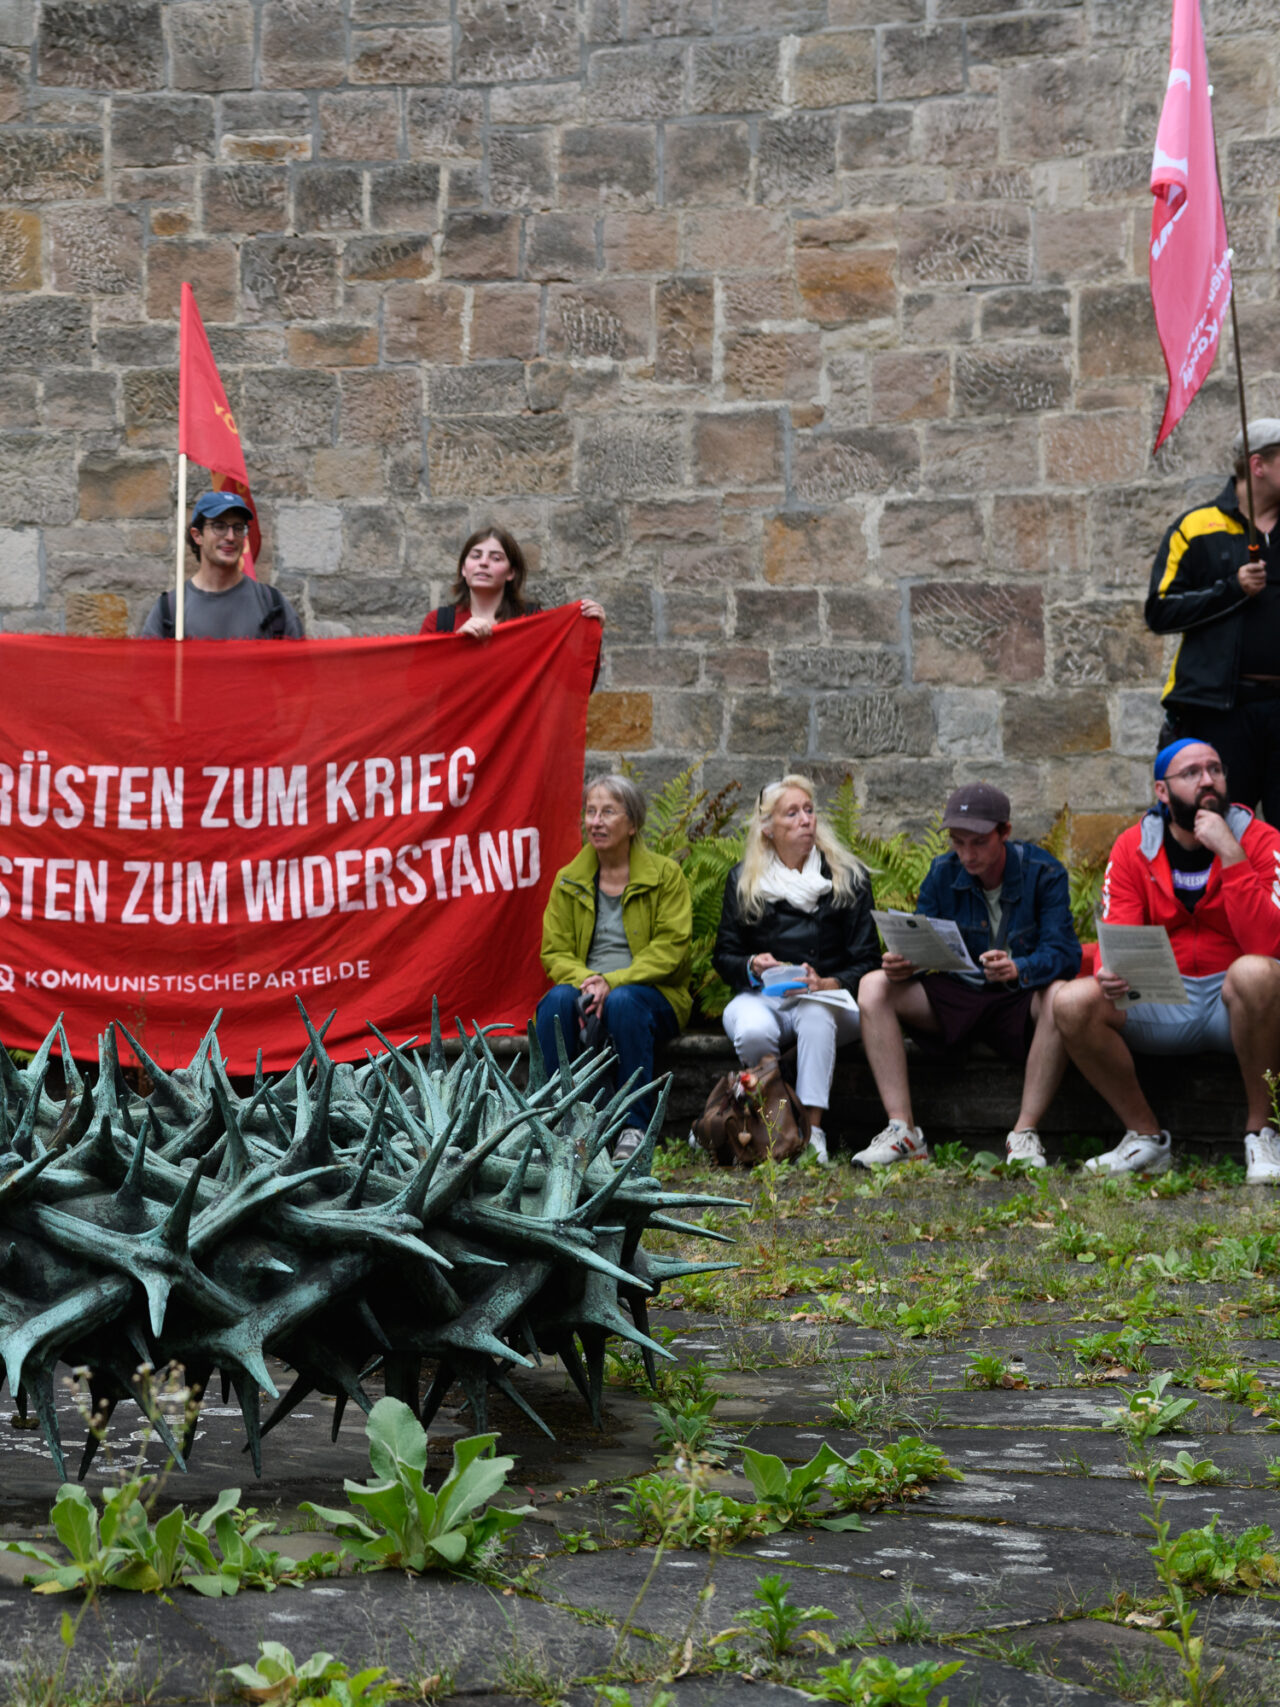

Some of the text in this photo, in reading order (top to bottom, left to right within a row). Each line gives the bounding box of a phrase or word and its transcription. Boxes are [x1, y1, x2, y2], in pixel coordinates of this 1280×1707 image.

[200, 765, 308, 829] ZUM
[325, 746, 476, 824] KRIEG
[121, 860, 228, 925] ZUM
[240, 827, 541, 923] WIDERSTAND
[24, 960, 371, 993] KOMMUNISTISCHEPARTEI.DE
